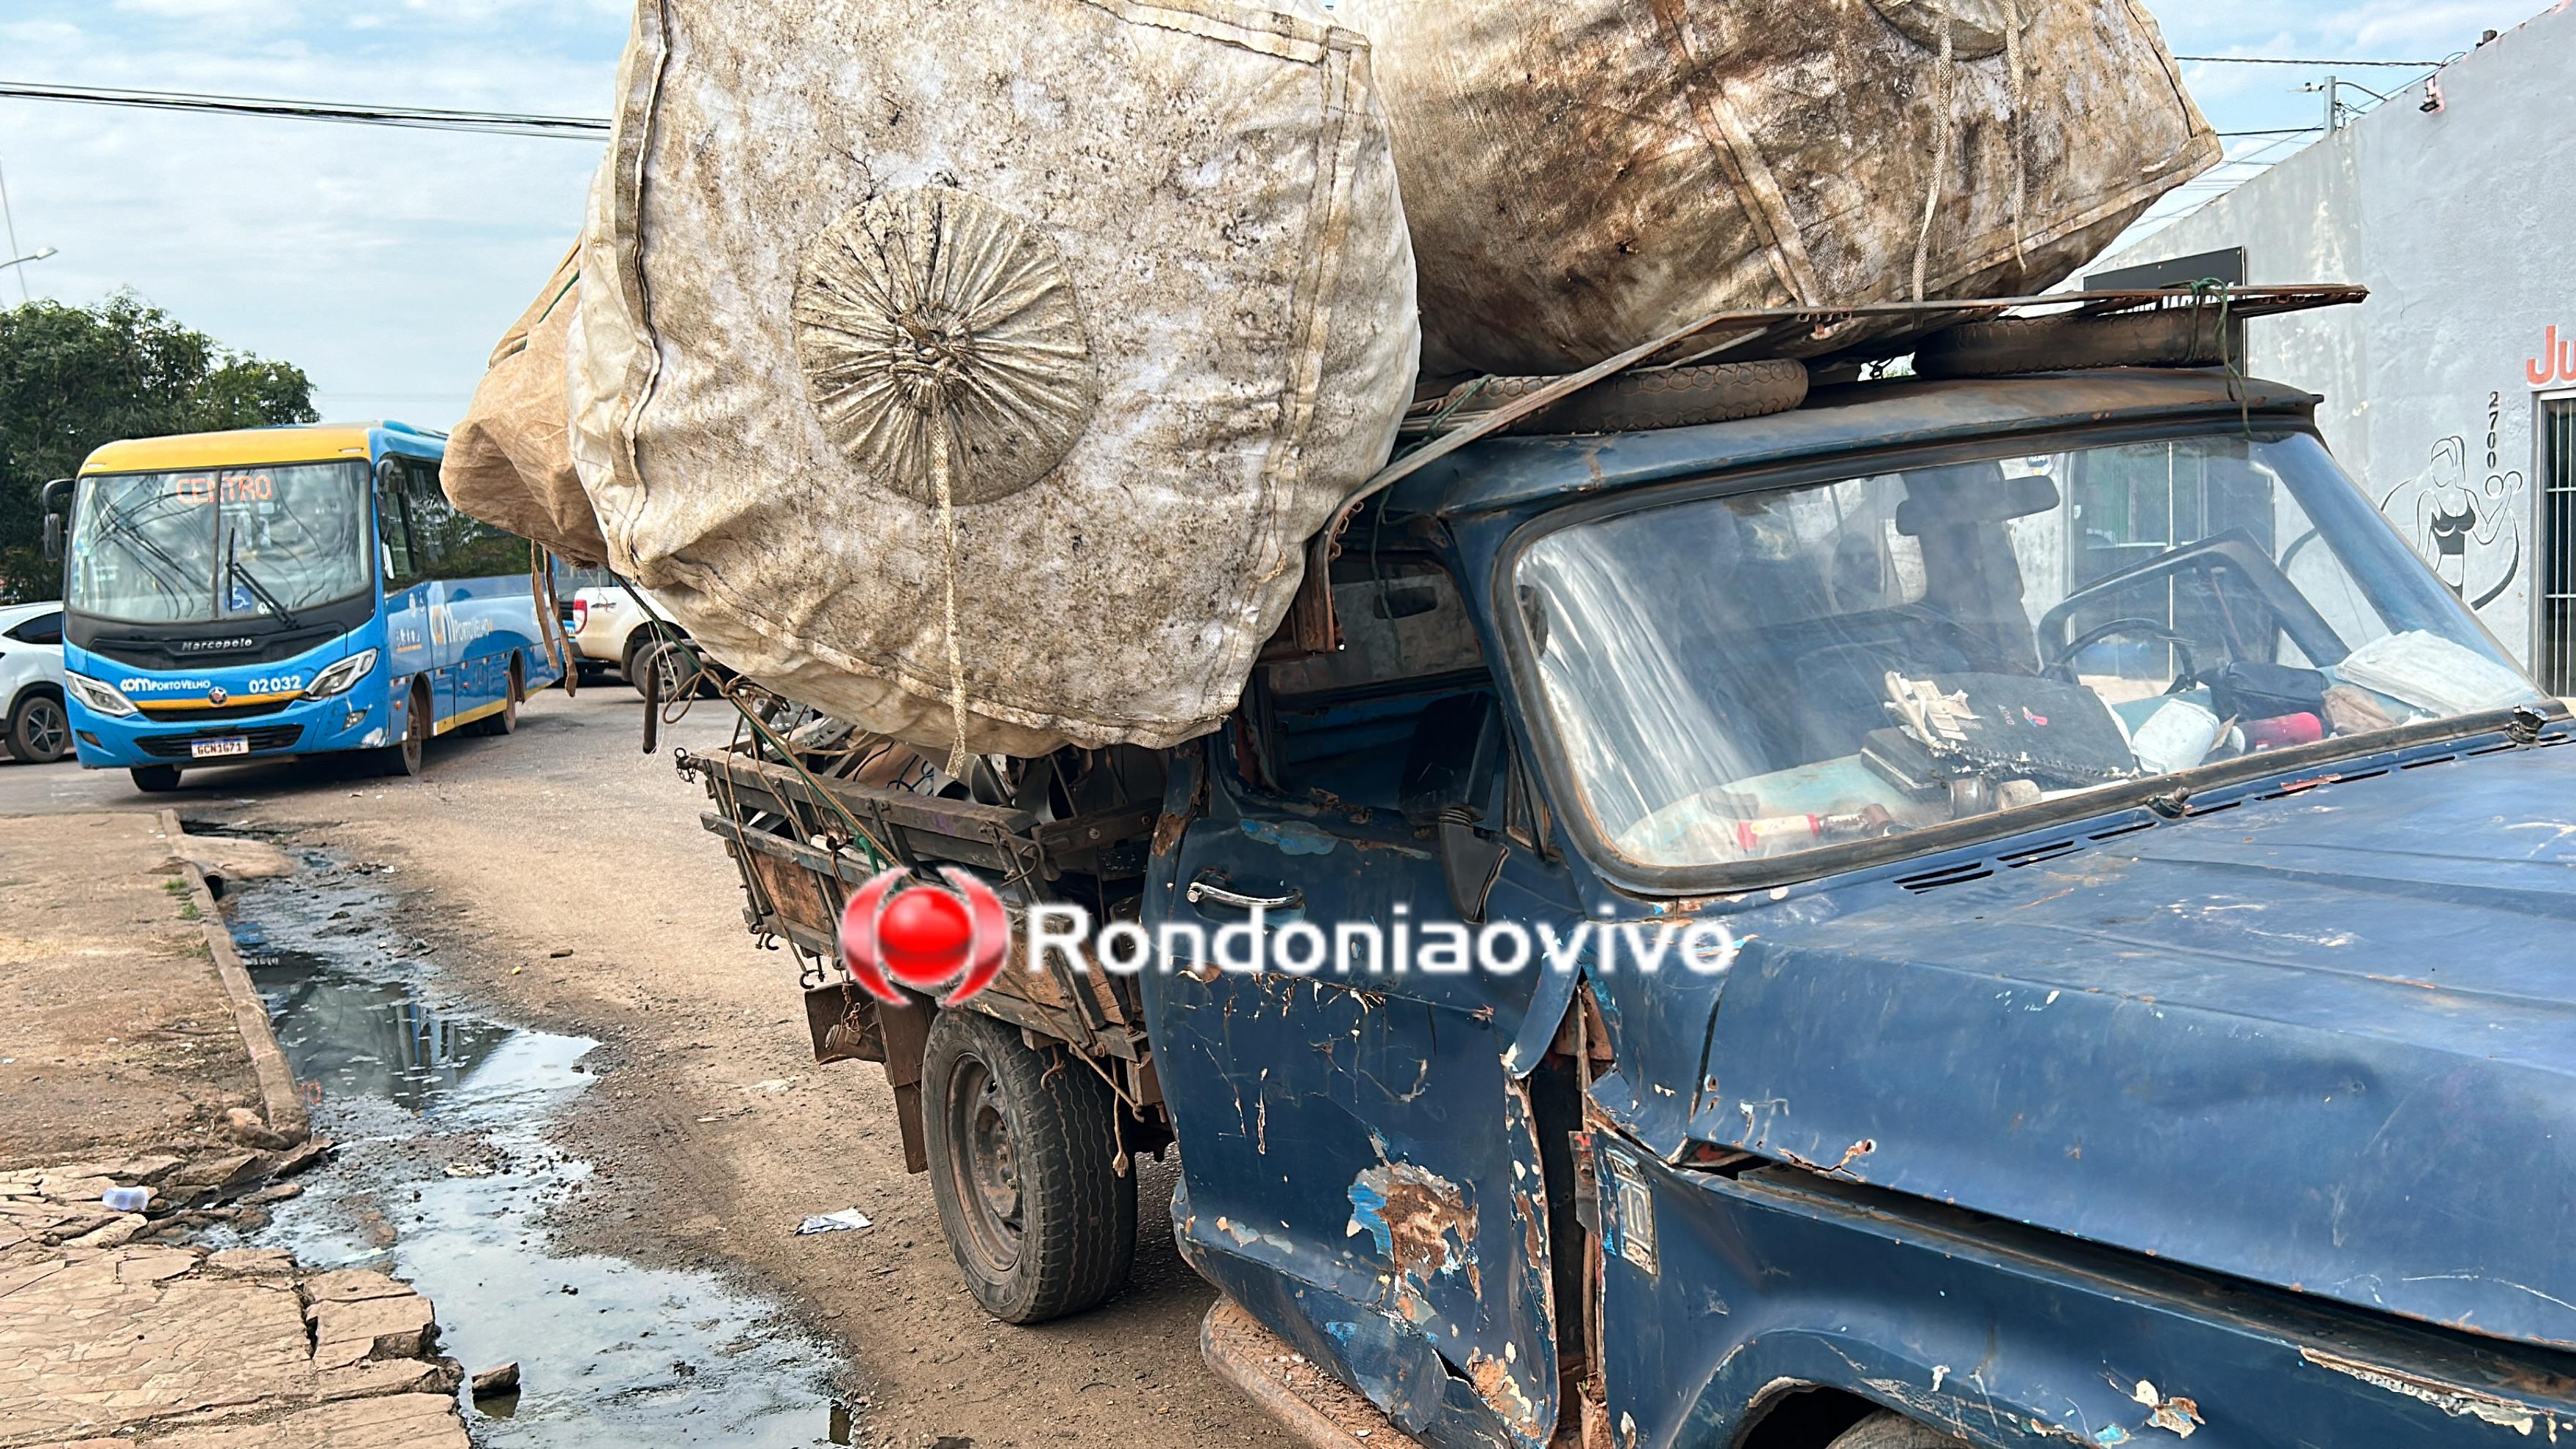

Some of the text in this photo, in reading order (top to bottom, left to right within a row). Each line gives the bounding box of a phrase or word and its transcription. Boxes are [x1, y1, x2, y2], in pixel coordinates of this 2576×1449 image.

[2486, 391, 2500, 468] 2700
[176, 475, 273, 504] CENTRO
[181, 637, 252, 651] Marcopolo
[198, 743, 242, 755] GCN1G71
